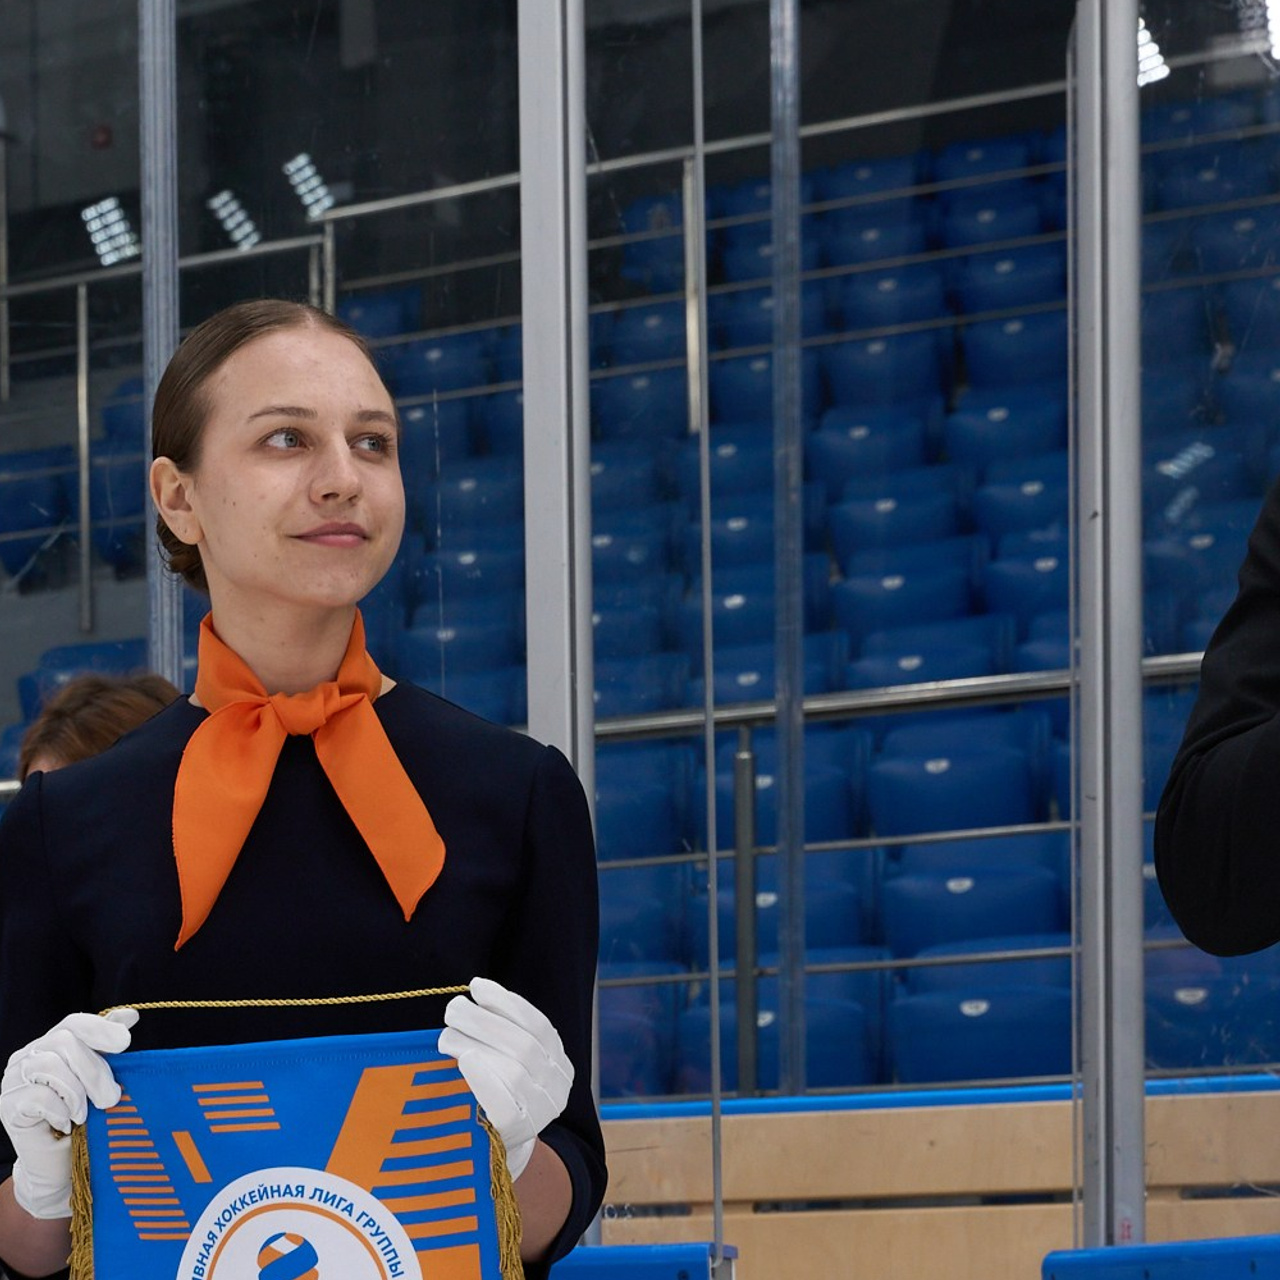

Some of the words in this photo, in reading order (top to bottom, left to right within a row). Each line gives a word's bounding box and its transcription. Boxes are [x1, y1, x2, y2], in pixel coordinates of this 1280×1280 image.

[215, 1183, 305, 1230] ХОККЕЙНАЯ
[308, 1187, 355, 1217] ЛИГА
[356, 1210, 404, 1278] ГРУППЫ
